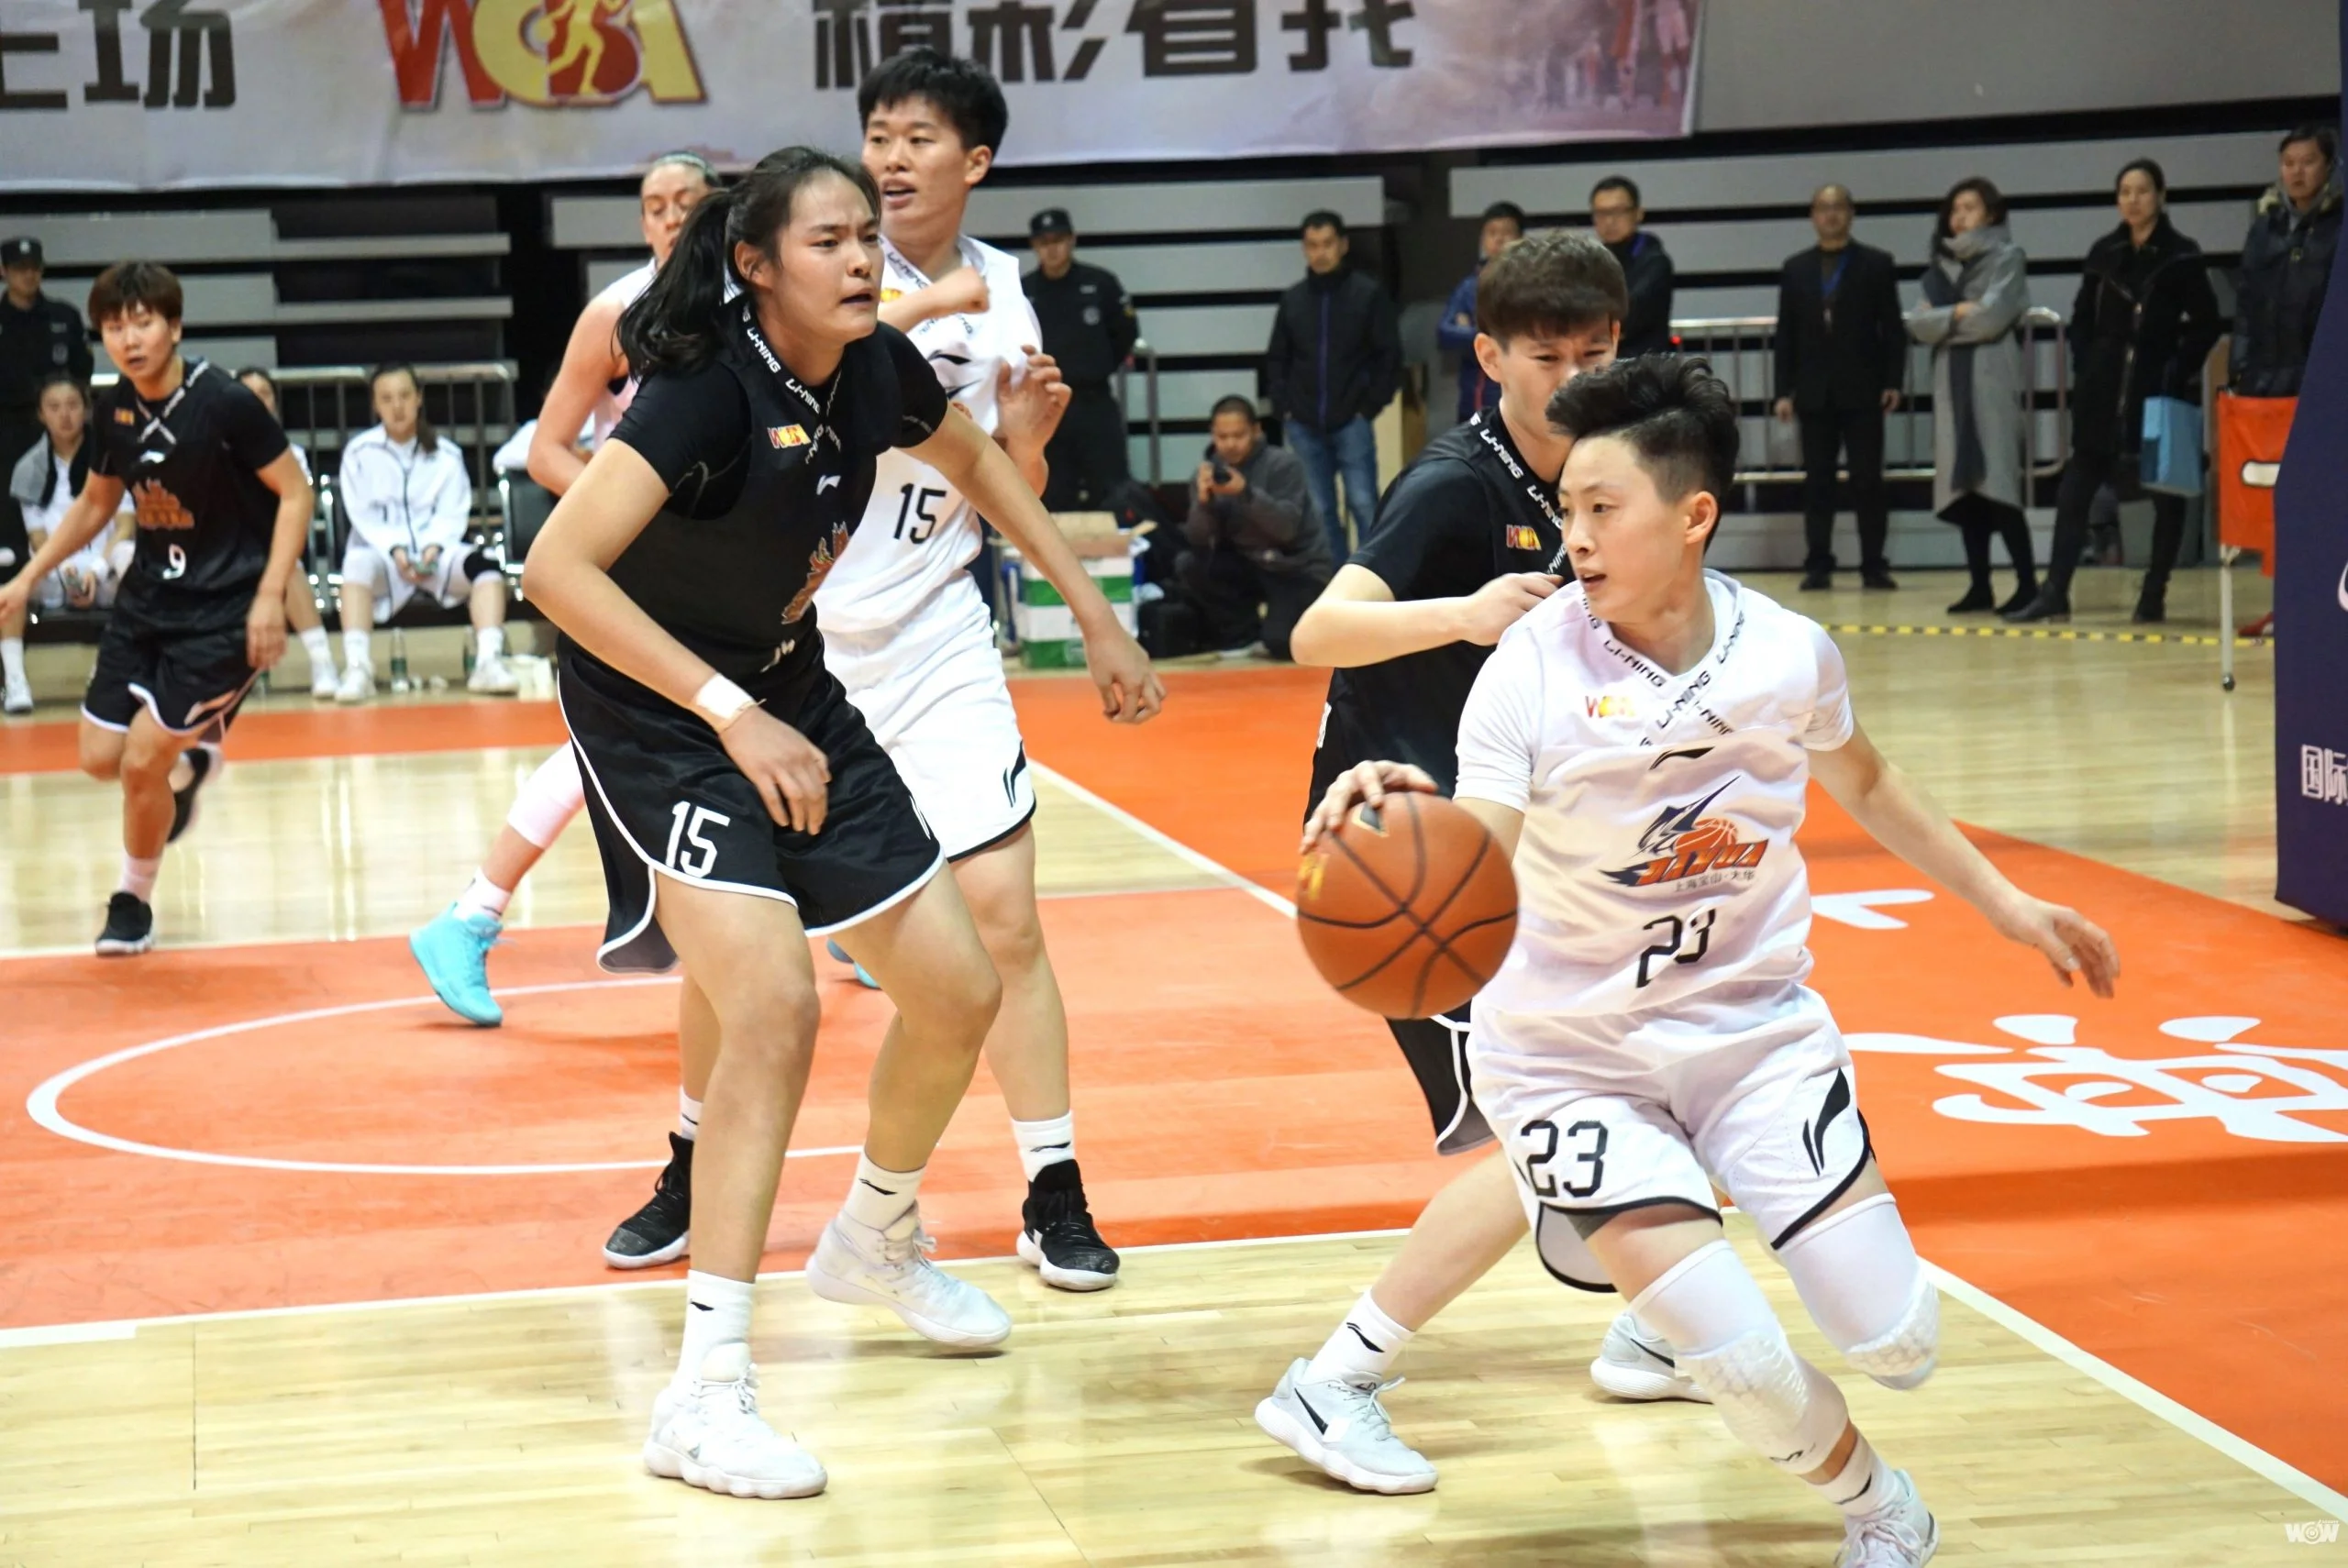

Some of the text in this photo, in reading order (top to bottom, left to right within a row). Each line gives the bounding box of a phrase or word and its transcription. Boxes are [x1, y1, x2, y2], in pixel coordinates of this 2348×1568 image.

[747, 326, 781, 373] LI-NING
[1479, 427, 1524, 479] LI-NING
[892, 482, 946, 544] 15
[162, 544, 186, 580] 9
[1603, 639, 1667, 688] LI-NING
[1656, 670, 1711, 729] LI-NING
[667, 801, 730, 878] 15
[1635, 908, 1716, 988] 23
[1520, 1120, 1608, 1198] 23
